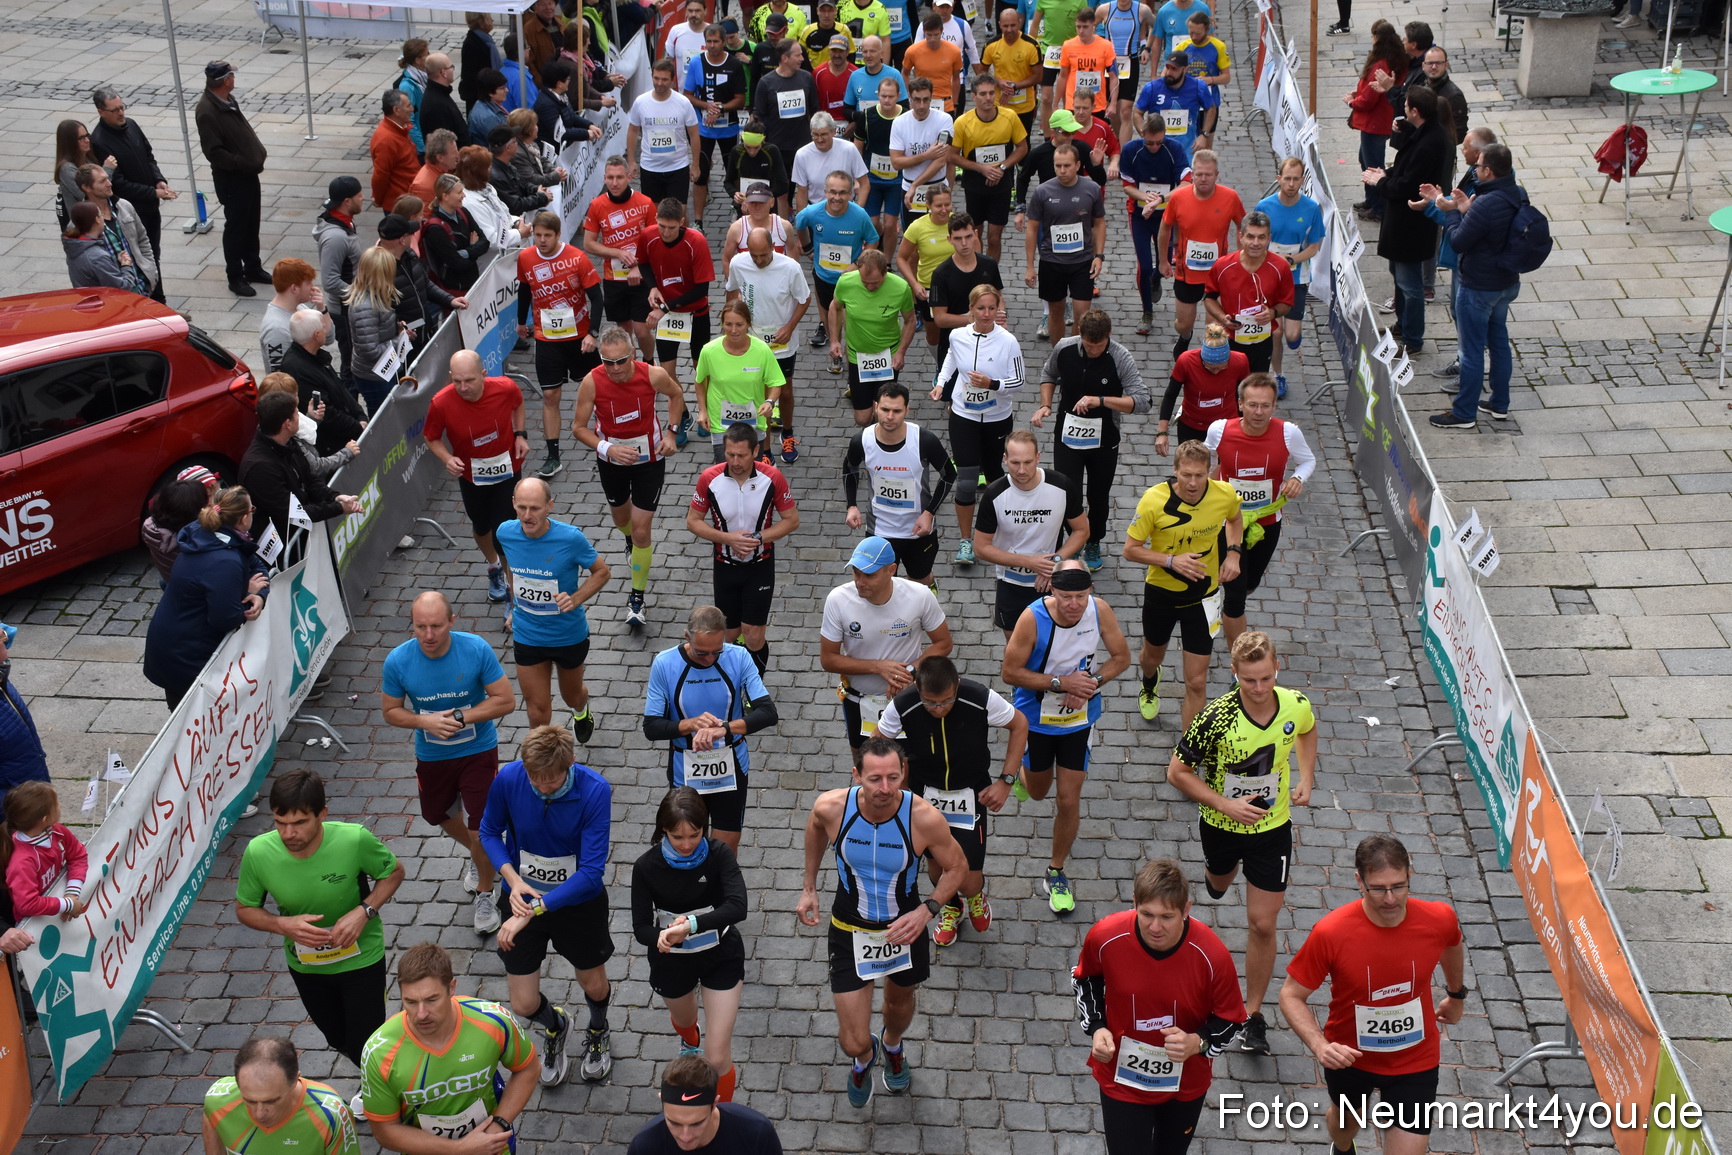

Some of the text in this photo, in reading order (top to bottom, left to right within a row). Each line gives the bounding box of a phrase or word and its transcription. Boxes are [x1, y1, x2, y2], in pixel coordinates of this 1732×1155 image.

[1077, 58, 1097, 68] RUN
[1079, 78, 1098, 86] 2124
[782, 98, 802, 109] 2737
[1155, 94, 1166, 105] 3
[1166, 117, 1182, 126] 178
[652, 137, 672, 148] 2759
[983, 153, 999, 163] 256
[877, 162, 891, 171] 111
[1056, 232, 1079, 243] 2910
[1349, 240, 1360, 257] swn
[829, 252, 841, 261] 59
[1190, 250, 1214, 260] 2540
[551, 318, 564, 328] 57
[666, 319, 684, 330] 189
[1244, 323, 1263, 334] 235
[1379, 345, 1389, 359] sw
[381, 358, 393, 374] swn
[862, 358, 888, 370] 2580
[966, 390, 990, 402] 2767
[725, 410, 752, 421] 2429
[1068, 426, 1096, 438] 2722
[477, 464, 507, 476] 2430
[13, 492, 31, 504] BMW
[32, 490, 44, 498] 1er.
[879, 487, 908, 500] 2051
[1235, 490, 1266, 501] 2088
[333, 472, 381, 564] BOCK
[1014, 516, 1044, 524] HÄCKL
[1460, 526, 1473, 544] sw
[263, 539, 275, 556] swn
[1478, 548, 1496, 569] swn
[510, 566, 553, 577] www.hasit.de
[519, 586, 552, 602] 2379
[416, 690, 469, 702] www.hasit.de
[1057, 704, 1075, 715] 78
[197, 680, 275, 826] BESSER
[691, 761, 728, 777] 2700
[1232, 786, 1271, 798] 2673
[930, 798, 968, 812] 2714
[527, 865, 568, 882] 2928
[146, 888, 193, 971] Service-Line:
[1567, 919, 1583, 950] für die
[1577, 914, 1599, 964] Neumarkts
[316, 950, 341, 960] Andreas
[862, 942, 902, 959] 2705
[1382, 987, 1401, 996] DEHN
[1146, 1020, 1163, 1029] DEHN
[1366, 1016, 1414, 1034] 2469
[1377, 1036, 1406, 1045] Berthold
[1127, 1054, 1174, 1074] 2439
[403, 1065, 492, 1106] BOCK
[1136, 1074, 1160, 1085] Markus
[432, 1117, 477, 1140] 2721
